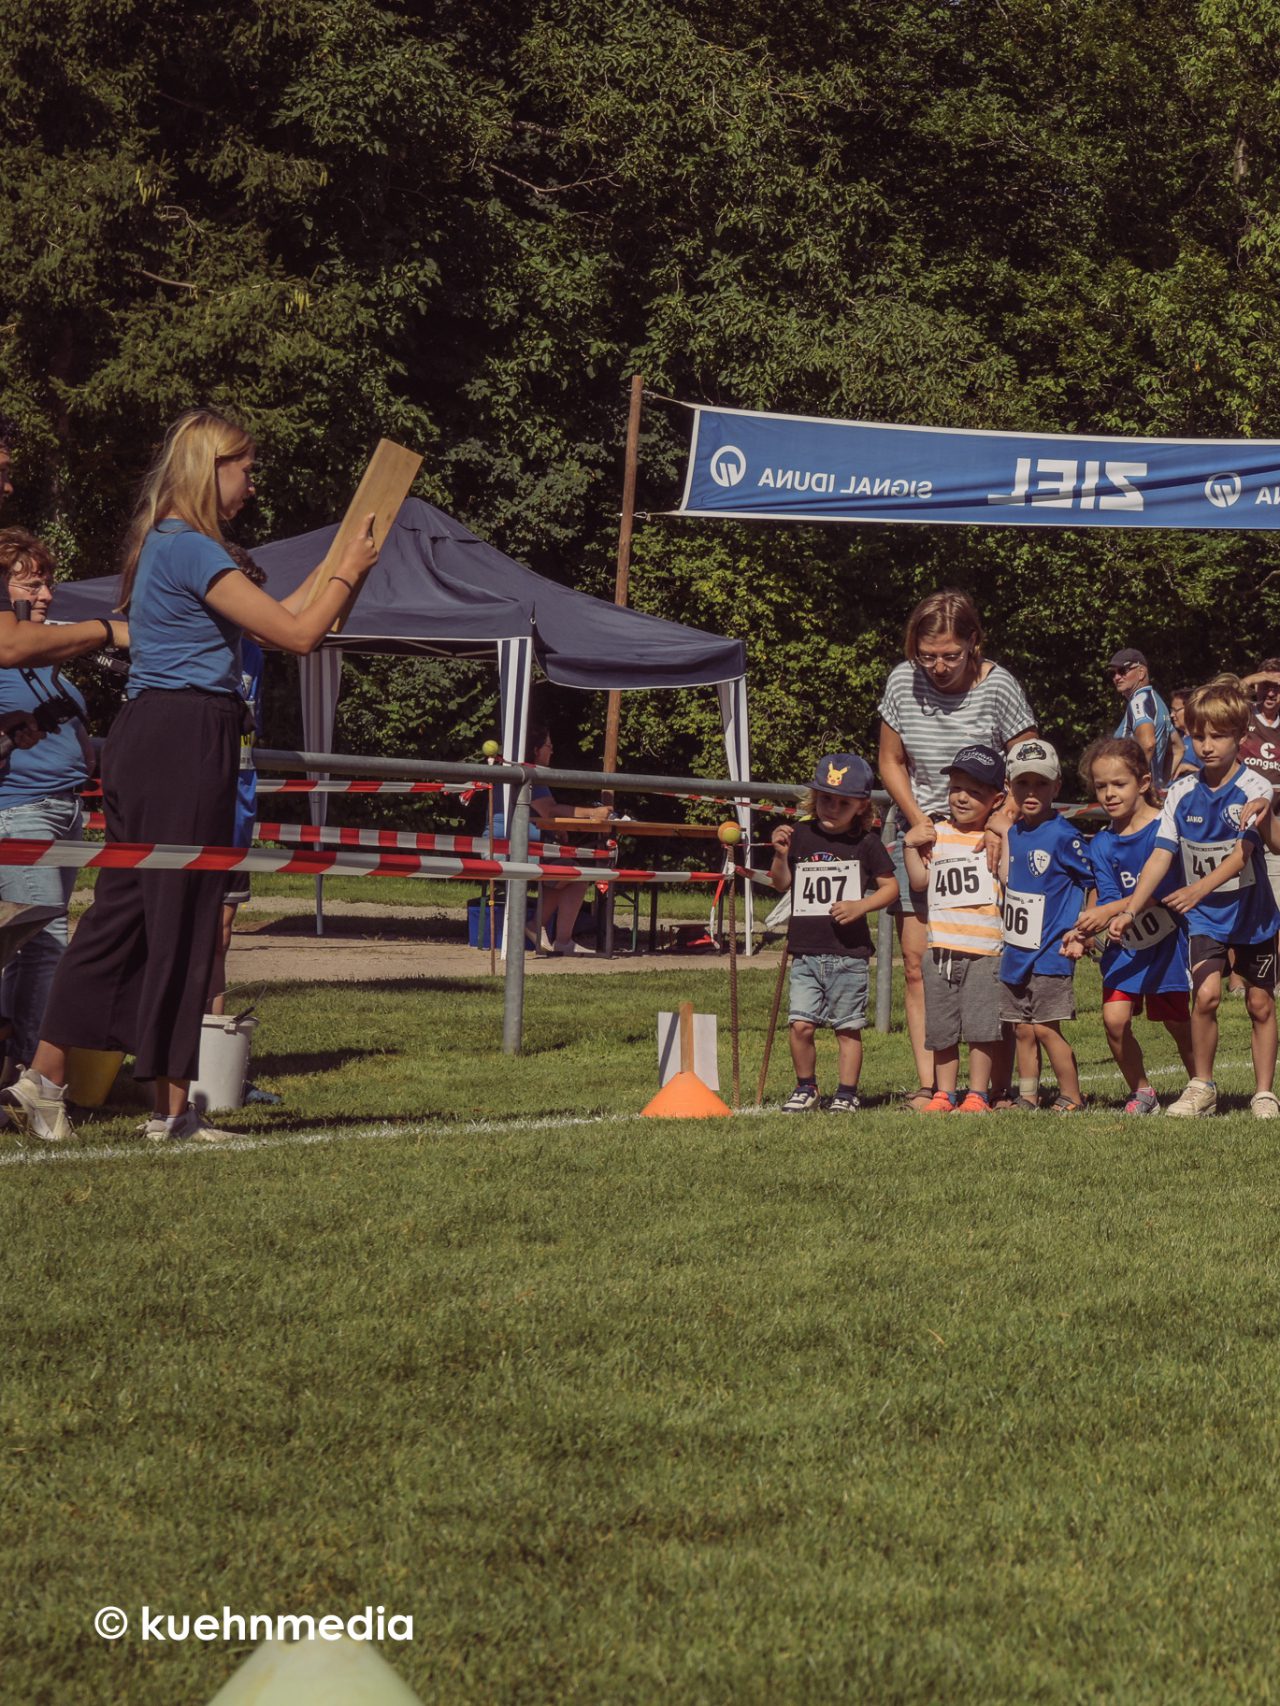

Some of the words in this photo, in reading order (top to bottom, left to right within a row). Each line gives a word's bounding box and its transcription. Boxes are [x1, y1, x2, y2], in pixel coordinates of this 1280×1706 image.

[1186, 815, 1203, 824] JAKO
[1193, 855, 1231, 878] 41
[802, 876, 847, 904] 407
[935, 866, 980, 897] 405
[1005, 903, 1029, 935] 06
[1126, 912, 1159, 941] 10
[1256, 954, 1273, 978] 7
